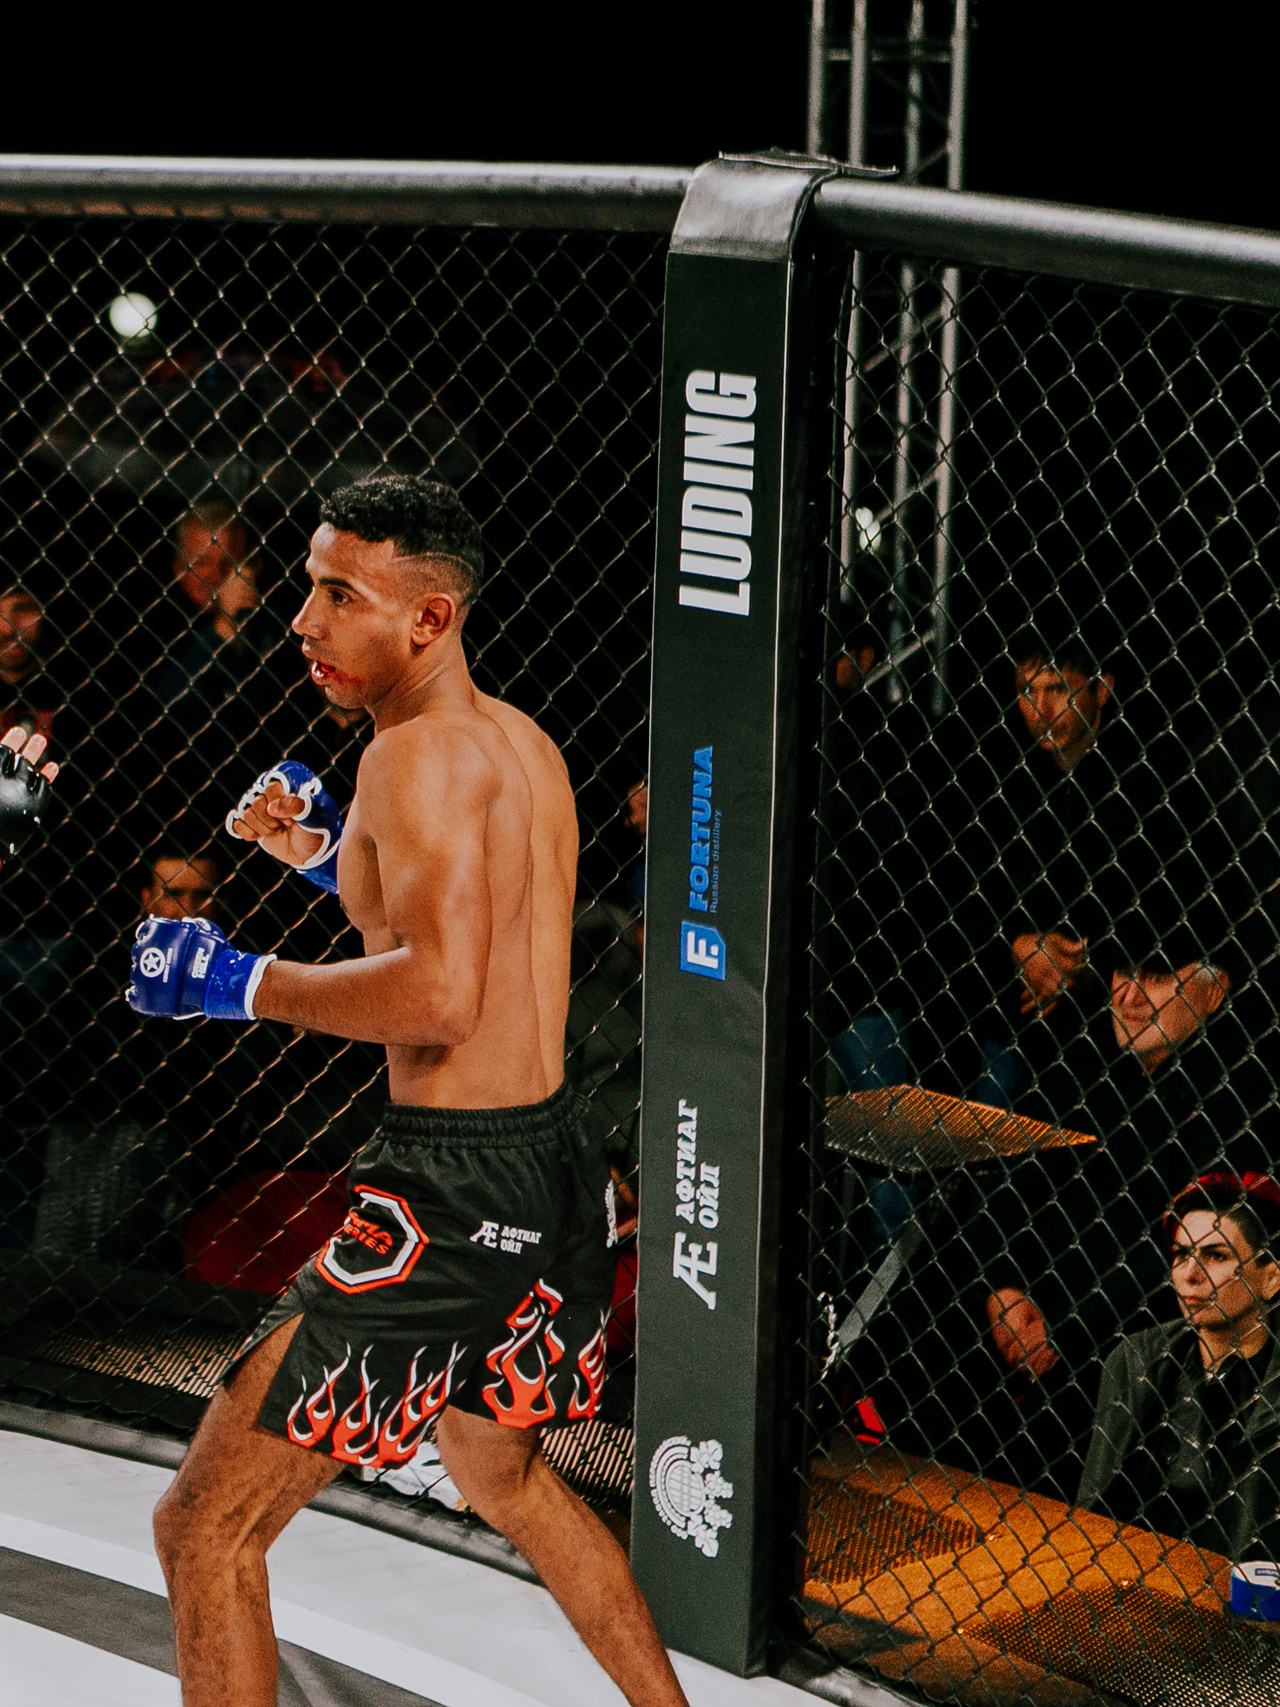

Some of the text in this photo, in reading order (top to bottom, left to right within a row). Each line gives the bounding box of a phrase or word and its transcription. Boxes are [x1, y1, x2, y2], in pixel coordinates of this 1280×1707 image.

[678, 370, 757, 617] LUDING
[688, 746, 714, 913] FORTUNA
[675, 1098, 698, 1225] АФТИАГ
[694, 1161, 720, 1229] ОЙЛ
